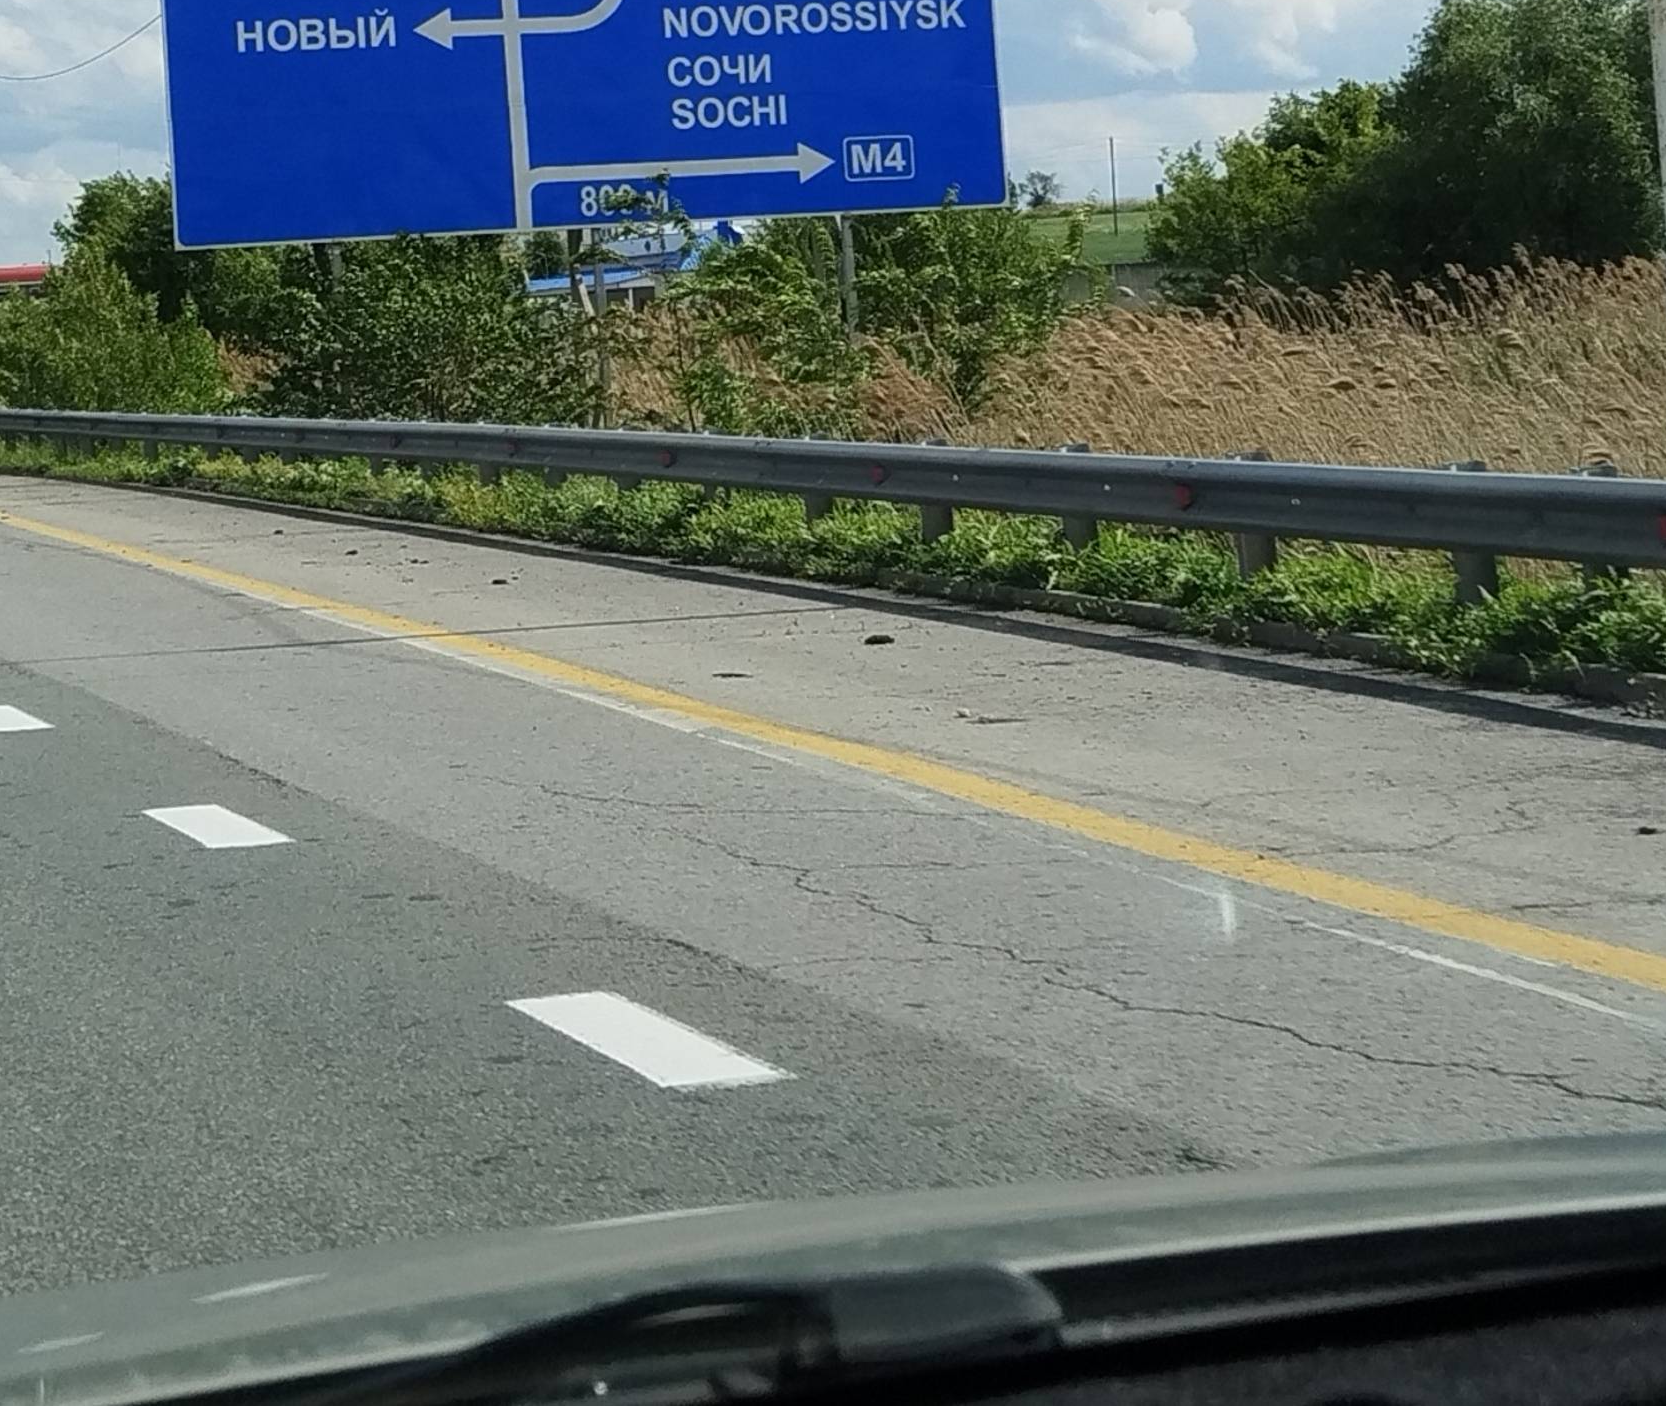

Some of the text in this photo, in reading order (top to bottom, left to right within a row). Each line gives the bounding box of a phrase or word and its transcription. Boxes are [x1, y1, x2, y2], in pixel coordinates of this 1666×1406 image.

[236, 9, 396, 52] НОВЫЙ
[667, 54, 771, 87] СОЧИ
[672, 94, 787, 130] SOCHI
